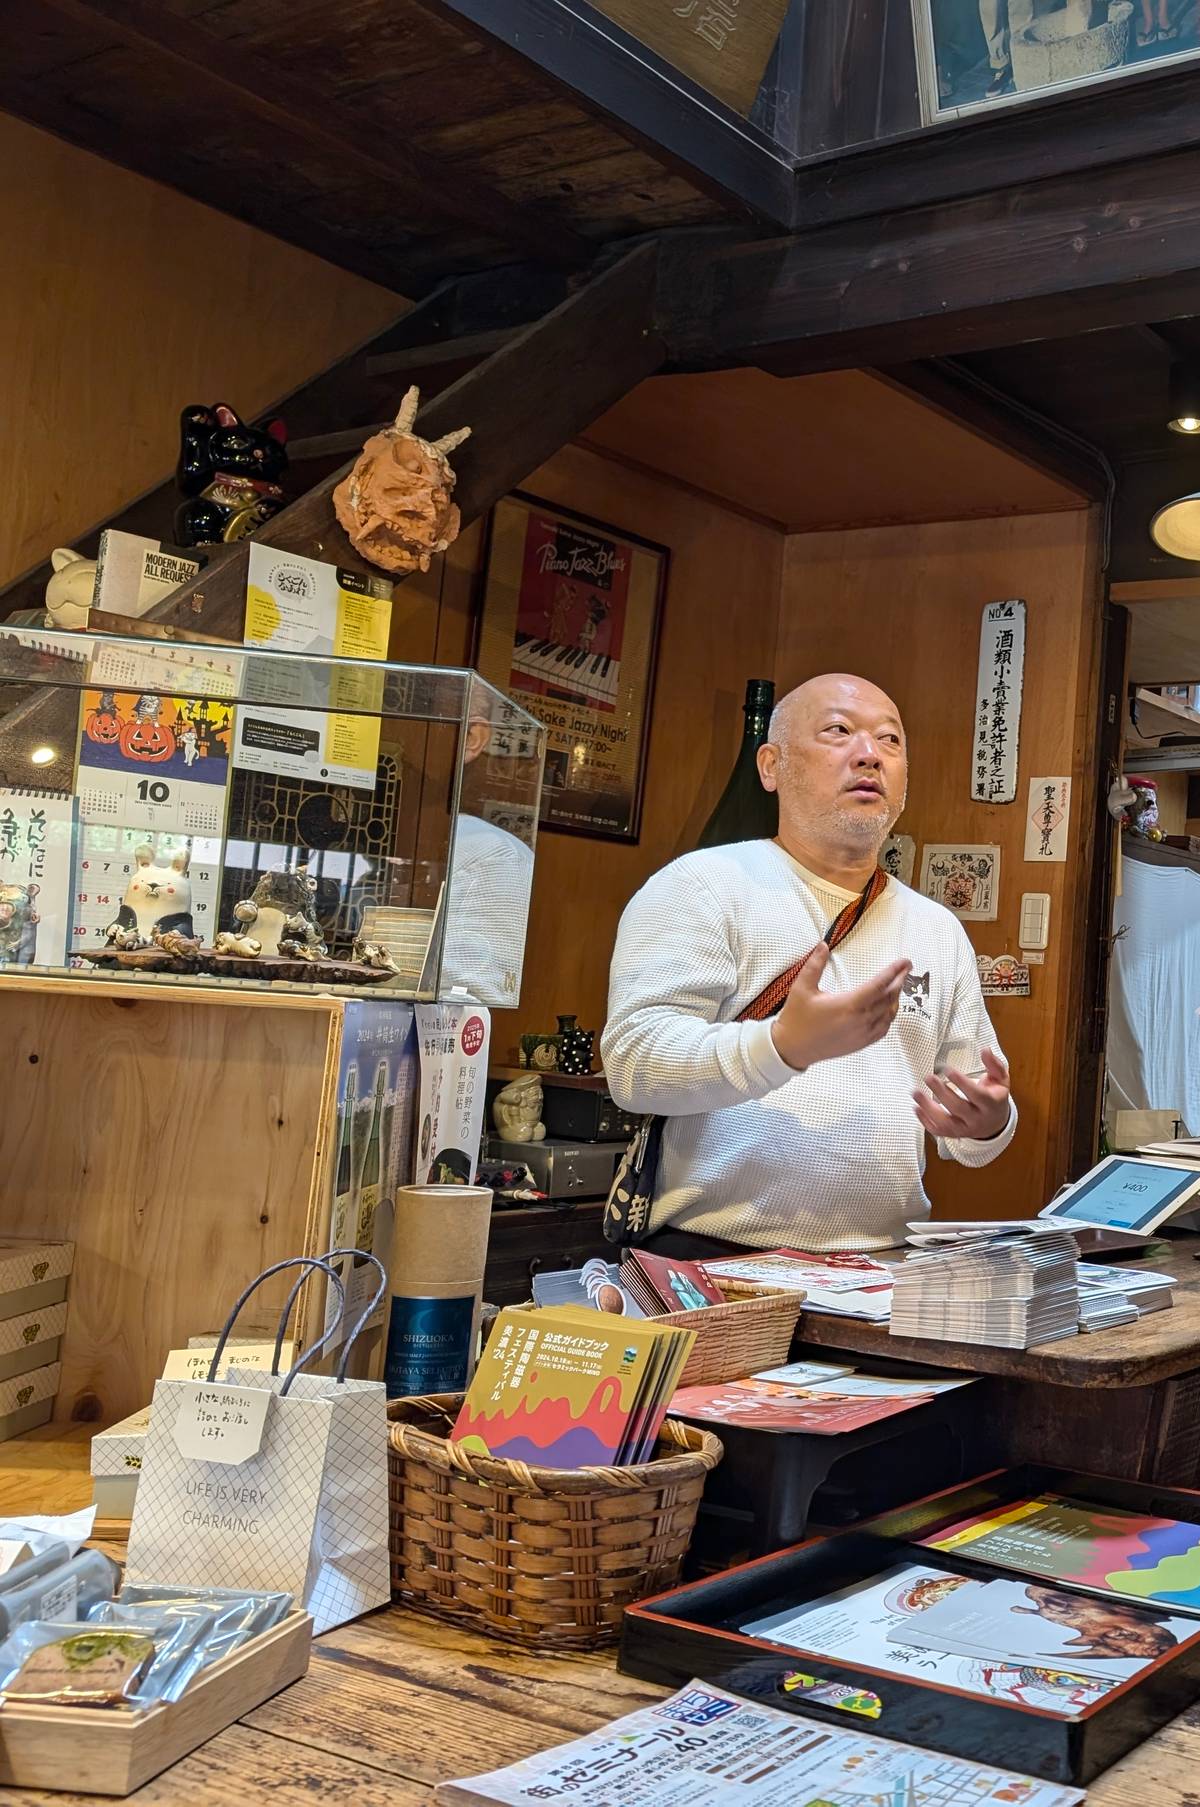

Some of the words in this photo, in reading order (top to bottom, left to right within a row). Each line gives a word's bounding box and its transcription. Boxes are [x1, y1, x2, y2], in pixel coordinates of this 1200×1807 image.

[145, 553, 177, 570] MODERN
[178, 563, 197, 576] JAZZ
[536, 543, 569, 574] Piano
[568, 547, 599, 577] Jazz
[597, 545, 626, 576] Blues
[144, 563, 159, 577] ALL
[538, 710, 566, 728] Sake
[569, 716, 599, 736] Jazzy
[600, 724, 628, 744] Night
[554, 731, 574, 745] SAT
[137, 780, 170, 803] 10
[27, 808, 47, 877] そんなに
[126, 832, 132, 840] 1
[146, 835, 153, 843] 2
[82, 861, 89, 869] 6
[103, 863, 110, 871] 7
[123, 865, 130, 873] 8
[199, 872, 209, 881] 12
[78, 894, 88, 902] 13
[96, 895, 109, 904] 14
[196, 904, 207, 912] 19
[73, 927, 86, 936] 20
[95, 928, 106, 937] 21
[70, 960, 83, 968] 27
[1122, 1182, 1149, 1193] ¥400
[402, 1334, 455, 1343] SHIZUOKA
[543, 1332, 610, 1352] 公式ガイドブック
[540, 1343, 568, 1354] OFFICIAL
[567, 1346, 586, 1357] GUIDE
[585, 1350, 603, 1360] BOOK
[490, 1327, 526, 1401] フェスティバル
[186, 1480, 212, 1498] LIFE
[214, 1486, 227, 1500] IS
[232, 1487, 267, 1505] VERY
[182, 1510, 260, 1535] CHARMING
[673, 1736, 709, 1753] 40
